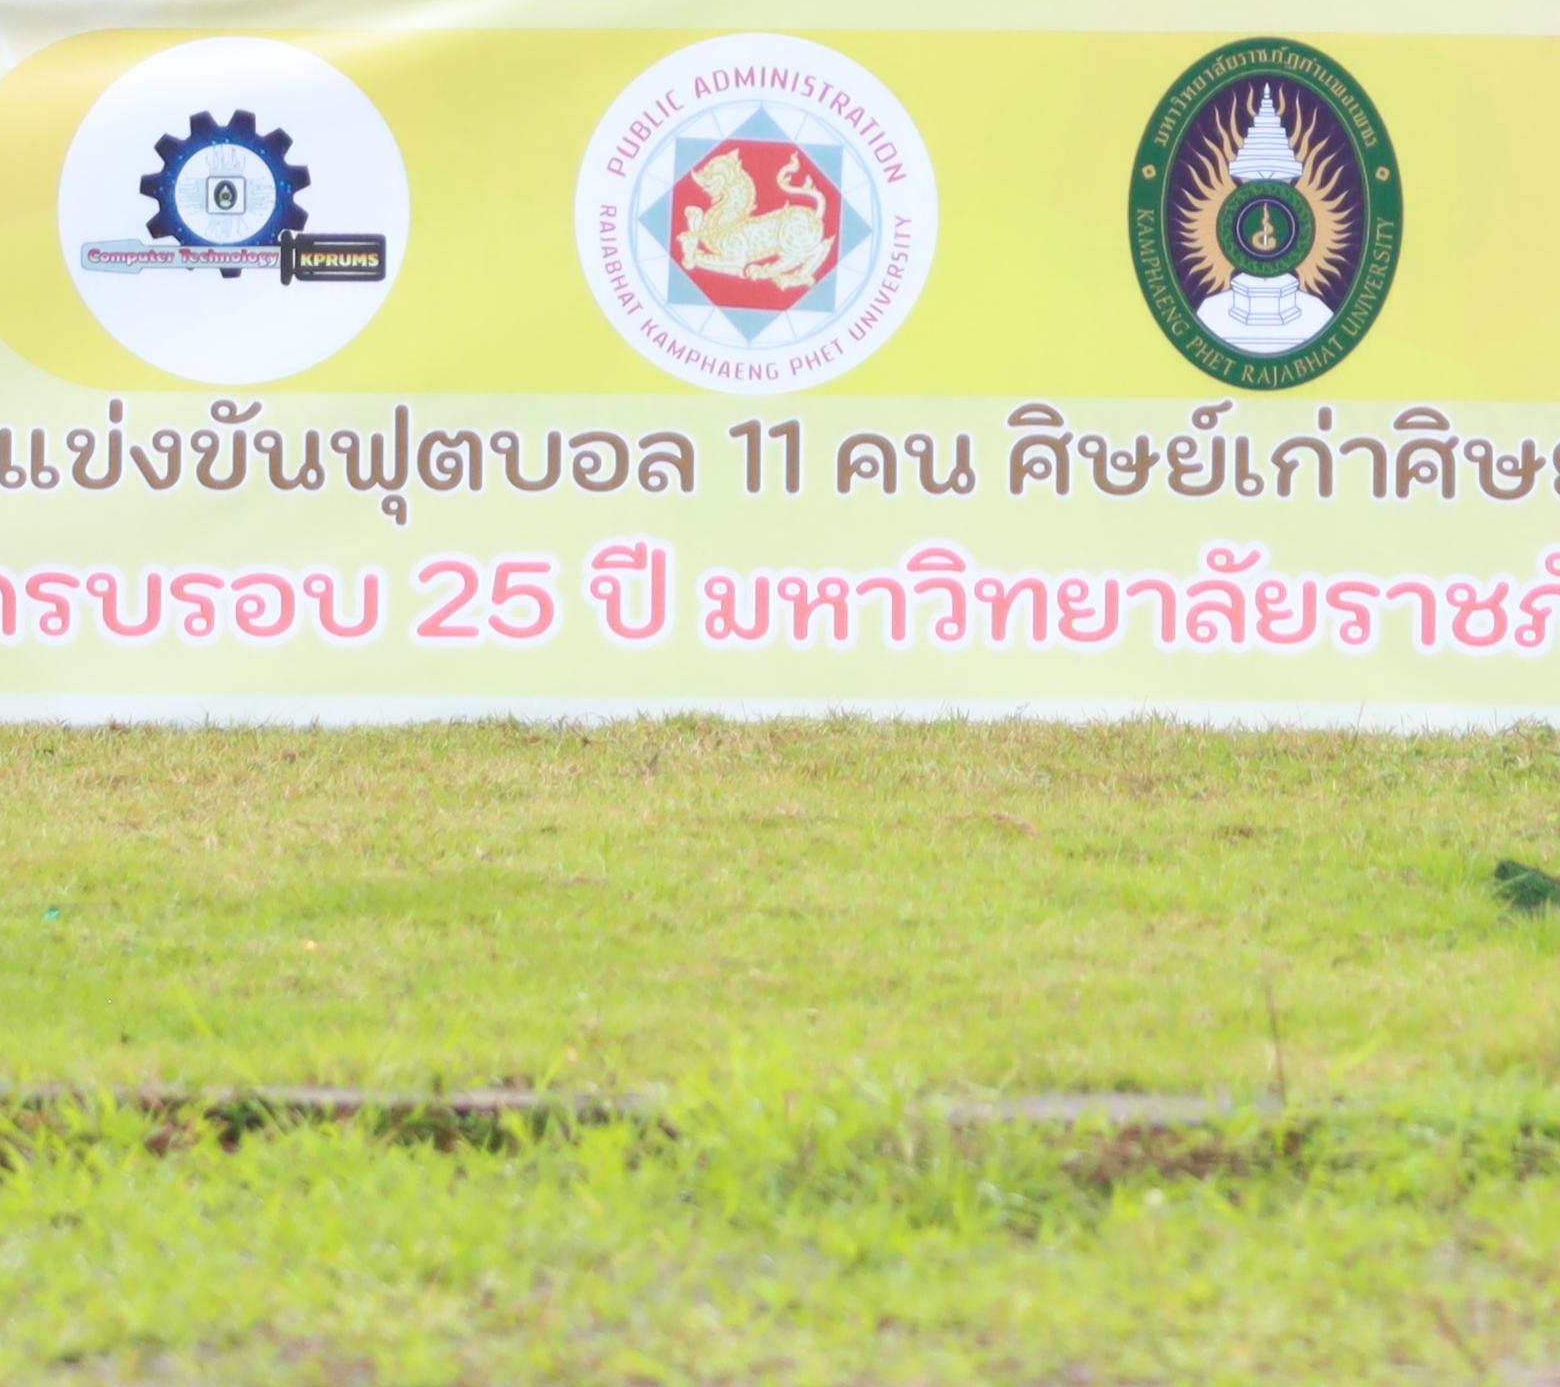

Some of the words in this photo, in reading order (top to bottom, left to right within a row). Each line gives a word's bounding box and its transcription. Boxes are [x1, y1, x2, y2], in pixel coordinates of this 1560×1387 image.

[605, 88, 685, 178] PUBLIC
[693, 65, 909, 185] ADMINISTRATION
[88, 248, 175, 267] Computer
[179, 247, 280, 268] Technology
[299, 251, 380, 268] KPRUMS
[639, 317, 780, 381] KAMPHAENG
[788, 336, 846, 377] PHET
[847, 214, 913, 343] UNIVERSITY
[1135, 207, 1192, 338] KAMPHAENG
[1185, 334, 1237, 377] PHET
[1241, 334, 1345, 389] RAJABHAT
[1341, 215, 1396, 339] UNIVERSITY
[729, 419, 804, 494] 11
[838, 431, 977, 496] คน
[415, 560, 555, 639] 25
[590, 541, 668, 641] ปี
